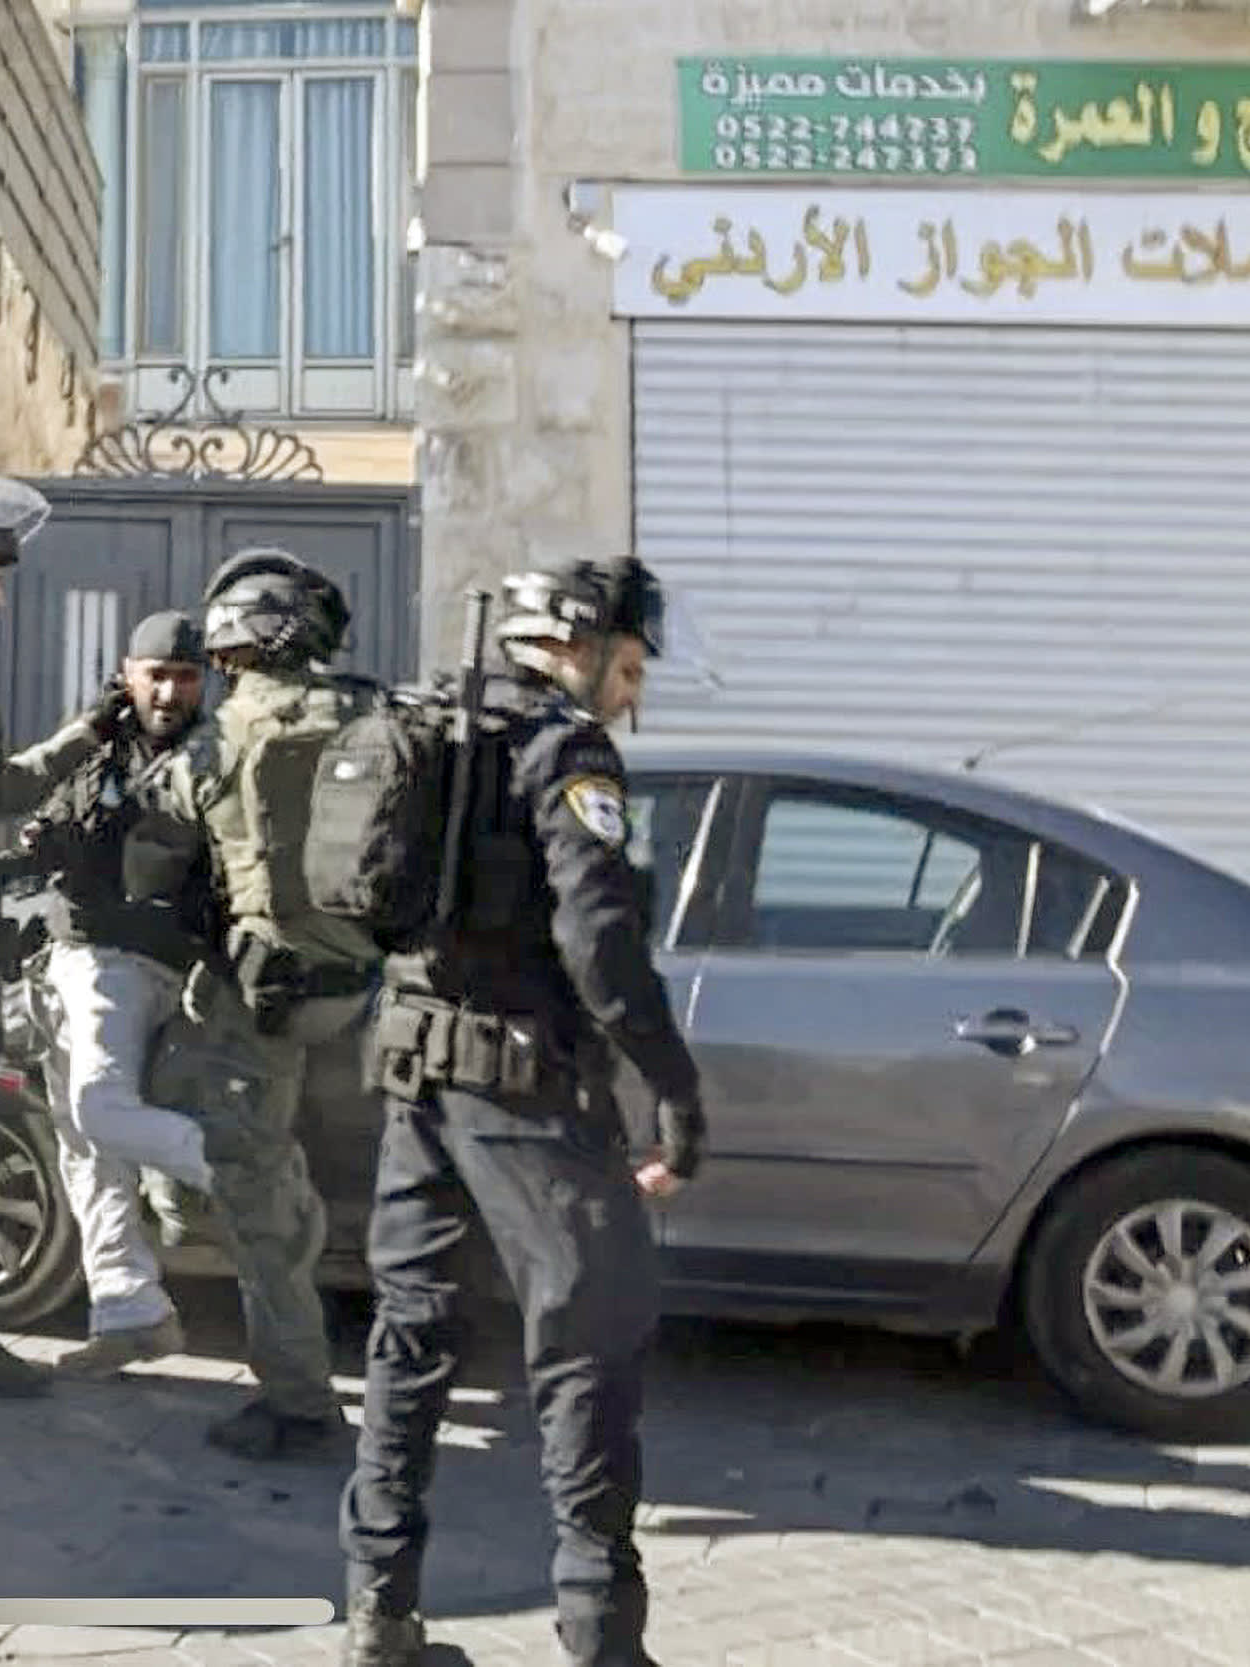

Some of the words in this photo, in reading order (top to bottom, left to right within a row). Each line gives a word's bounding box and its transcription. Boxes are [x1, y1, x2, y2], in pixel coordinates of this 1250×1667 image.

[701, 59, 827, 108] مميزة
[834, 60, 985, 107] بخدمات
[1010, 69, 1175, 163] العمرة
[651, 202, 871, 307] الأردني
[896, 212, 1093, 299] الجواز
